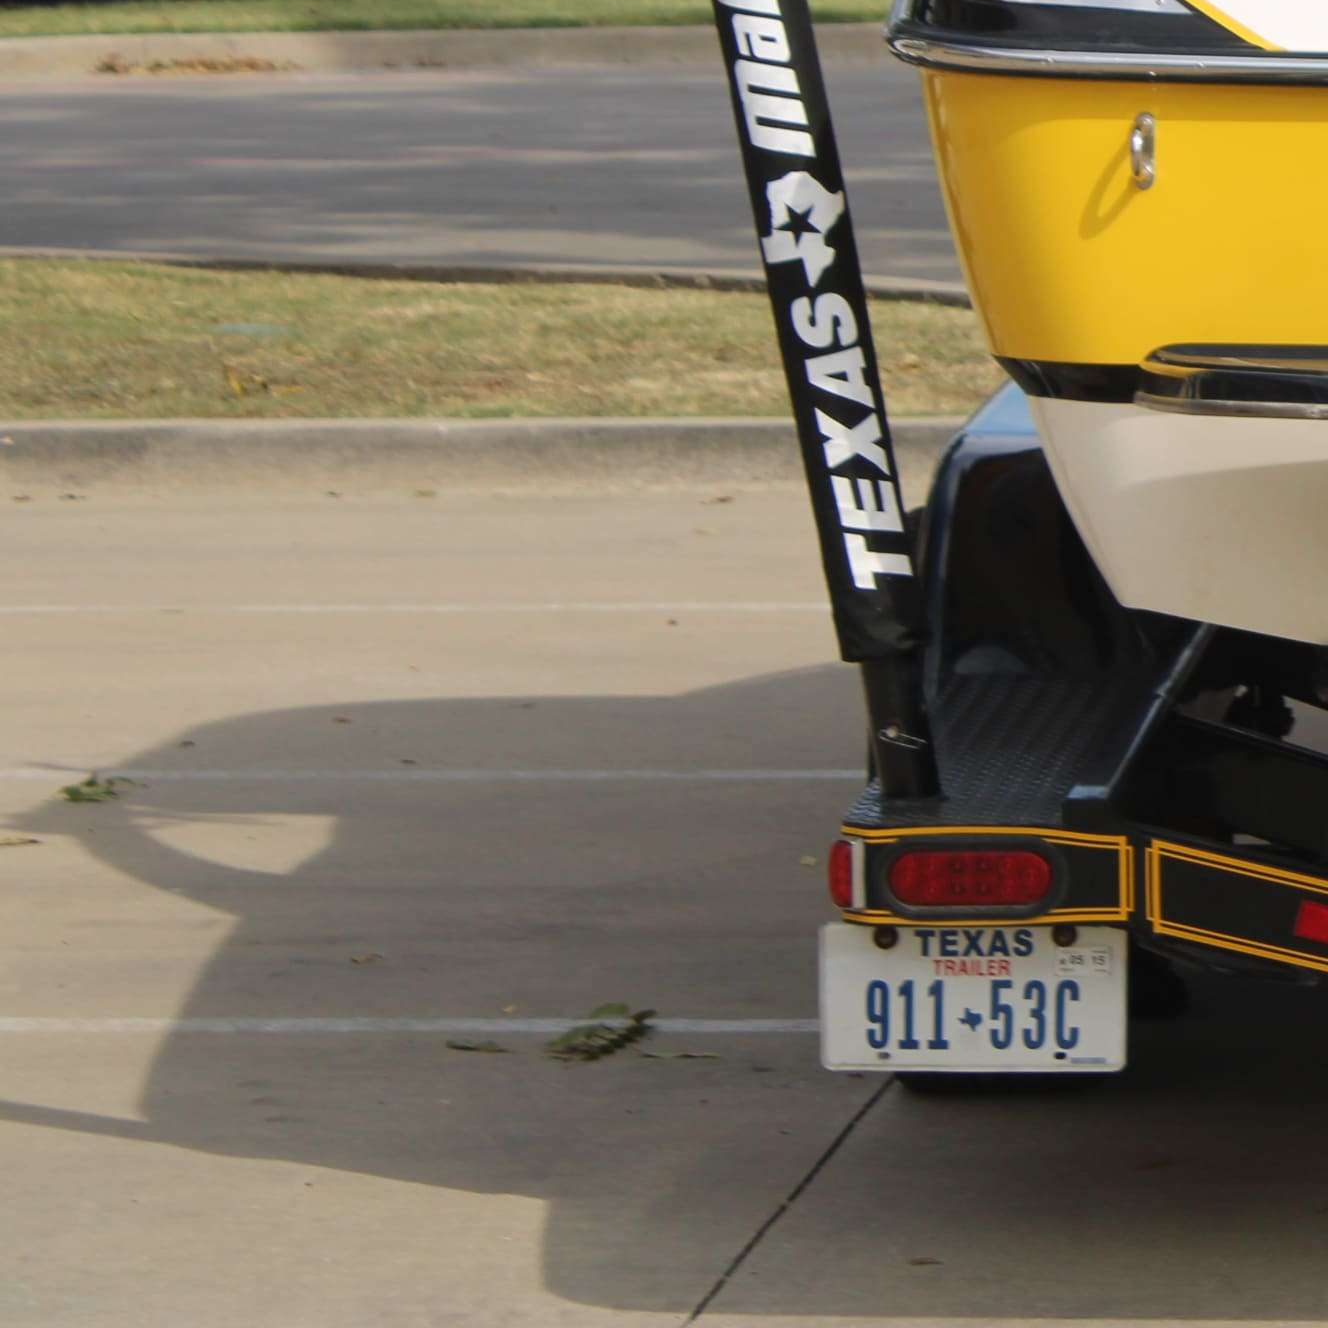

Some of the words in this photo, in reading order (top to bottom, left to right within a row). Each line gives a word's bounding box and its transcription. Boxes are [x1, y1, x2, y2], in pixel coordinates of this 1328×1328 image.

[790, 291, 913, 591] TEXAS
[914, 929, 1034, 957] TEXAS
[932, 959, 1012, 976] TRAILER
[866, 979, 950, 1050] 911
[989, 979, 1081, 1050] 53C
